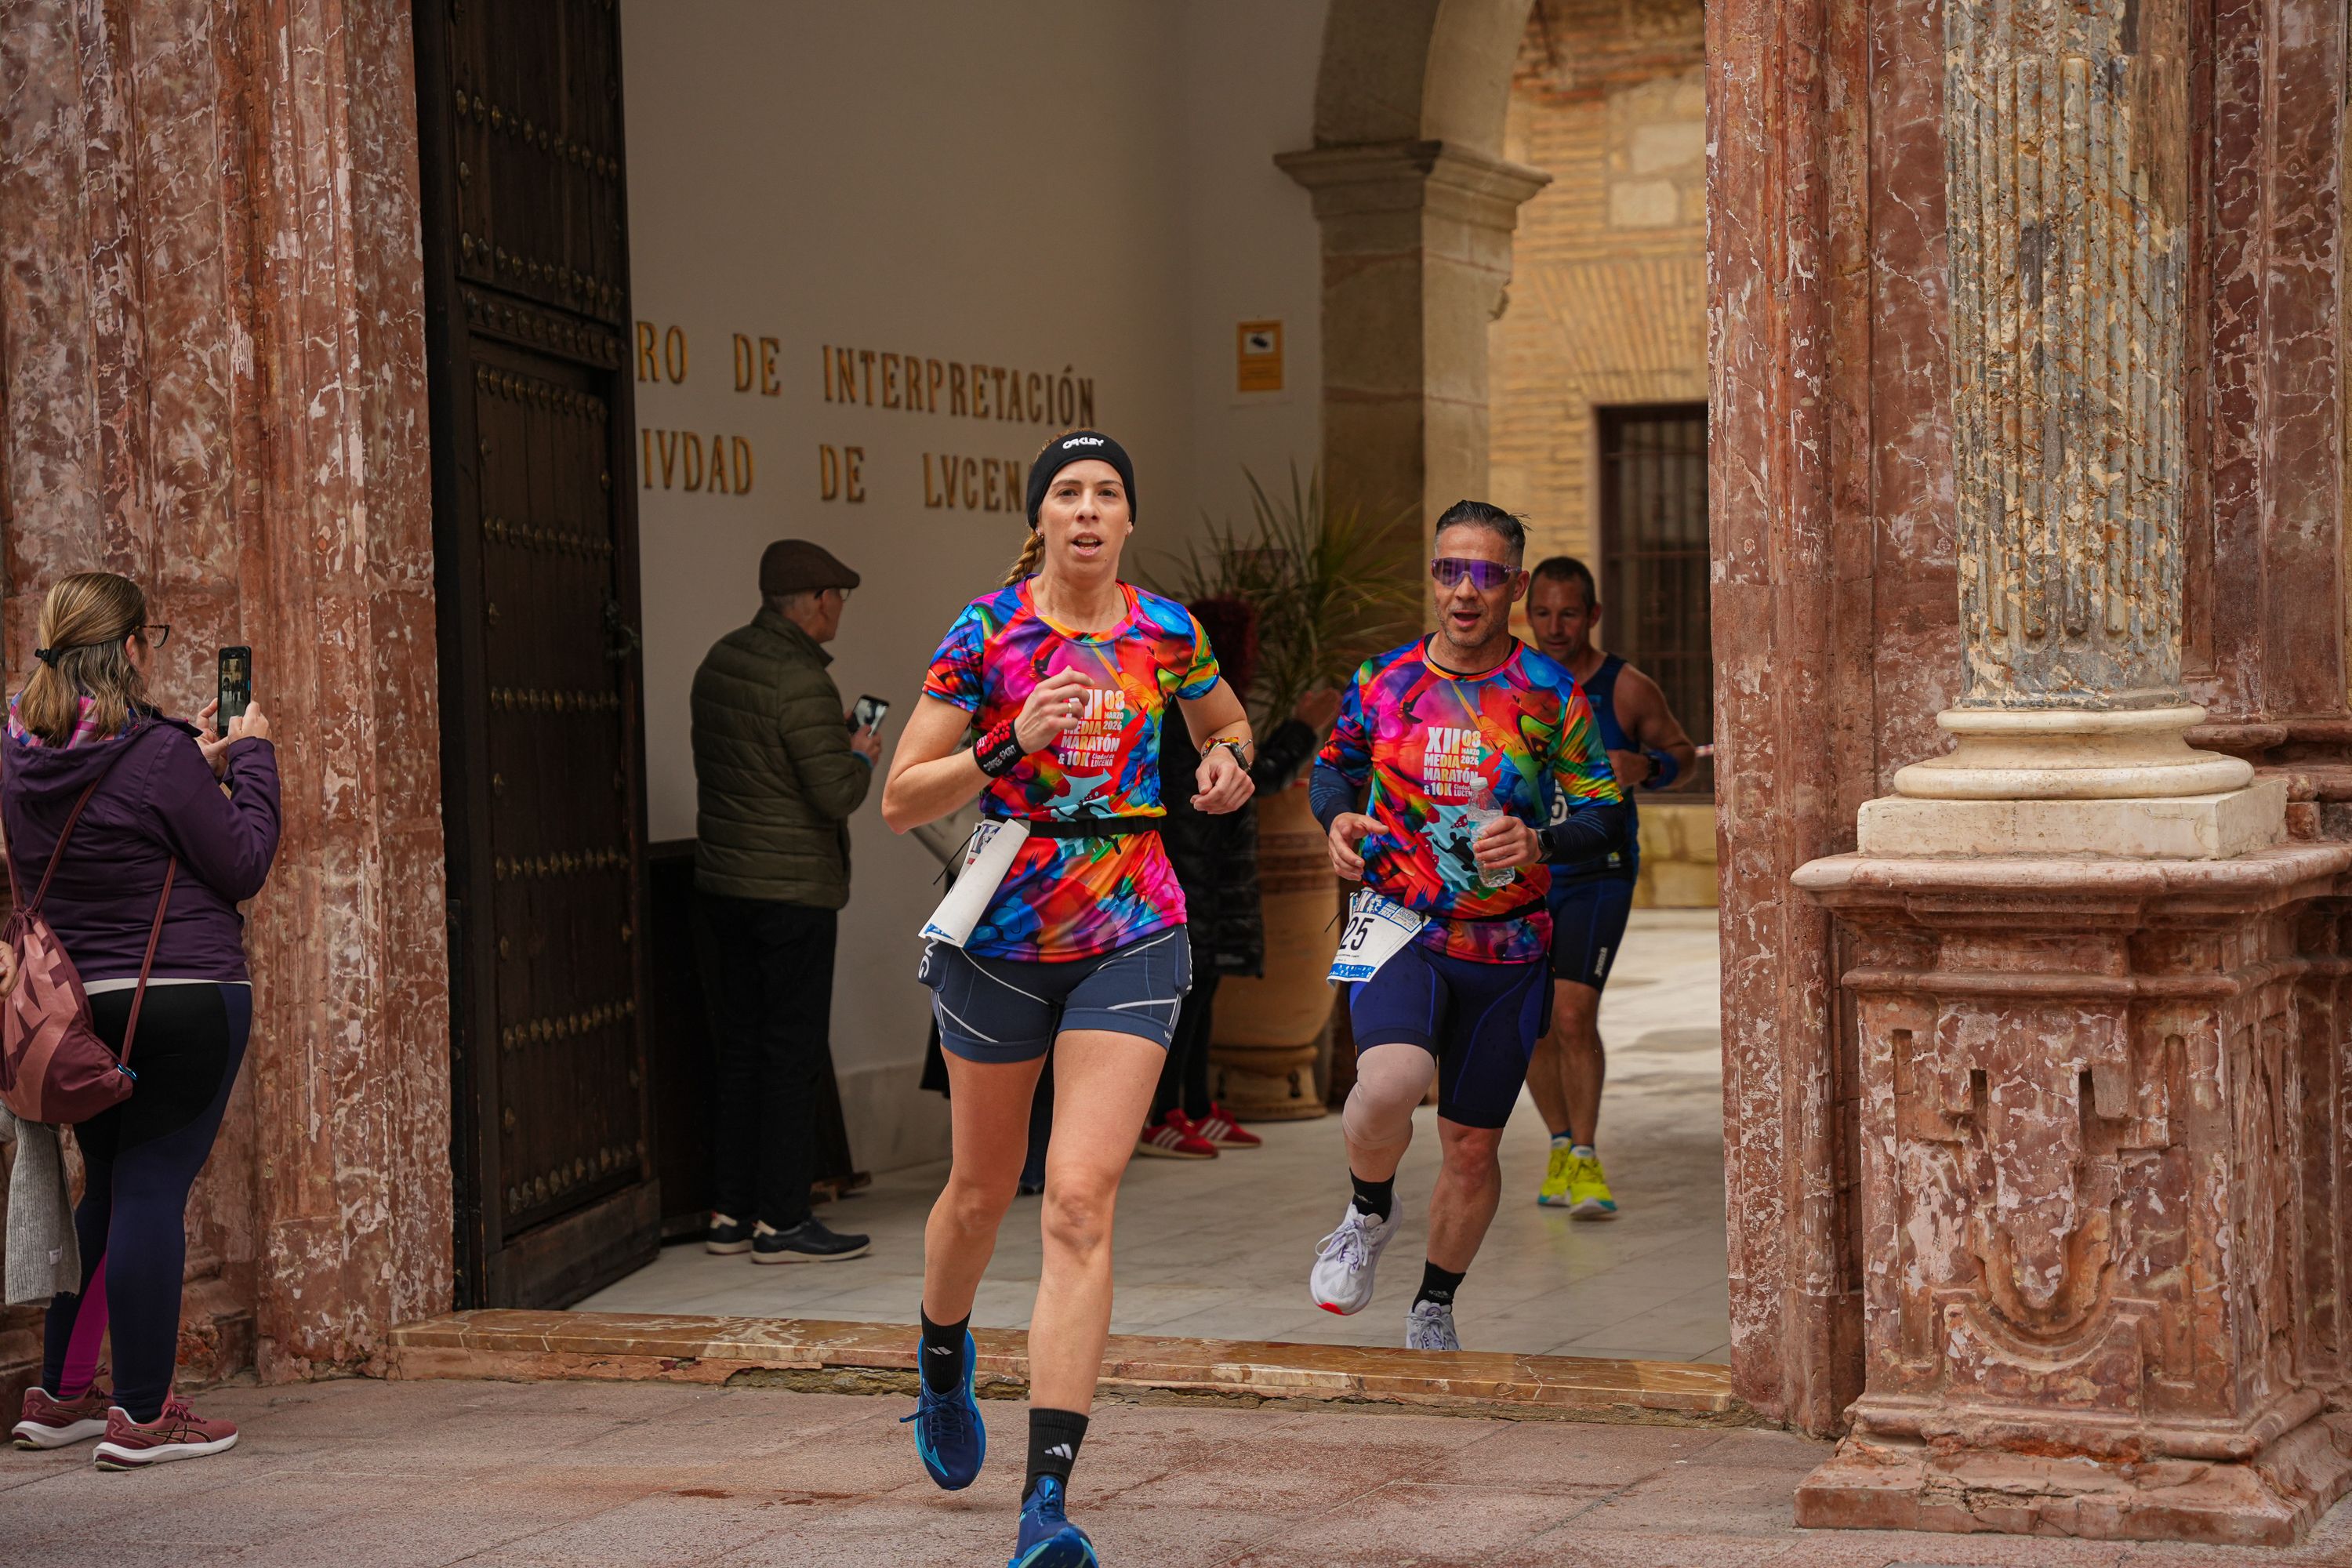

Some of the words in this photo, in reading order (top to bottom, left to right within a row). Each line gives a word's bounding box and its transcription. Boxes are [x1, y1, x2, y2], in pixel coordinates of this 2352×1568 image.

[733, 333, 781, 397] DE
[822, 343, 1095, 428] INTERPRETACIÓN
[1062, 437, 1104, 449] OAKLEY
[819, 443, 866, 503] DE
[1105, 690, 1125, 710] 08
[1105, 711, 1124, 720] MARZO
[1103, 720, 1123, 731] 2026
[1061, 734, 1120, 753] MARATÓN
[1425, 727, 1461, 754] XII
[1461, 729, 1482, 748] 08
[1058, 753, 1065, 764] &
[1067, 750, 1091, 767] 10K
[1091, 759, 1113, 768] LUCENA
[1424, 754, 1460, 768] MEDIA
[1461, 755, 1479, 765] 2026
[1424, 768, 1479, 783] MARATÓN
[1424, 785, 1430, 795] &
[1431, 782, 1452, 796] 10K
